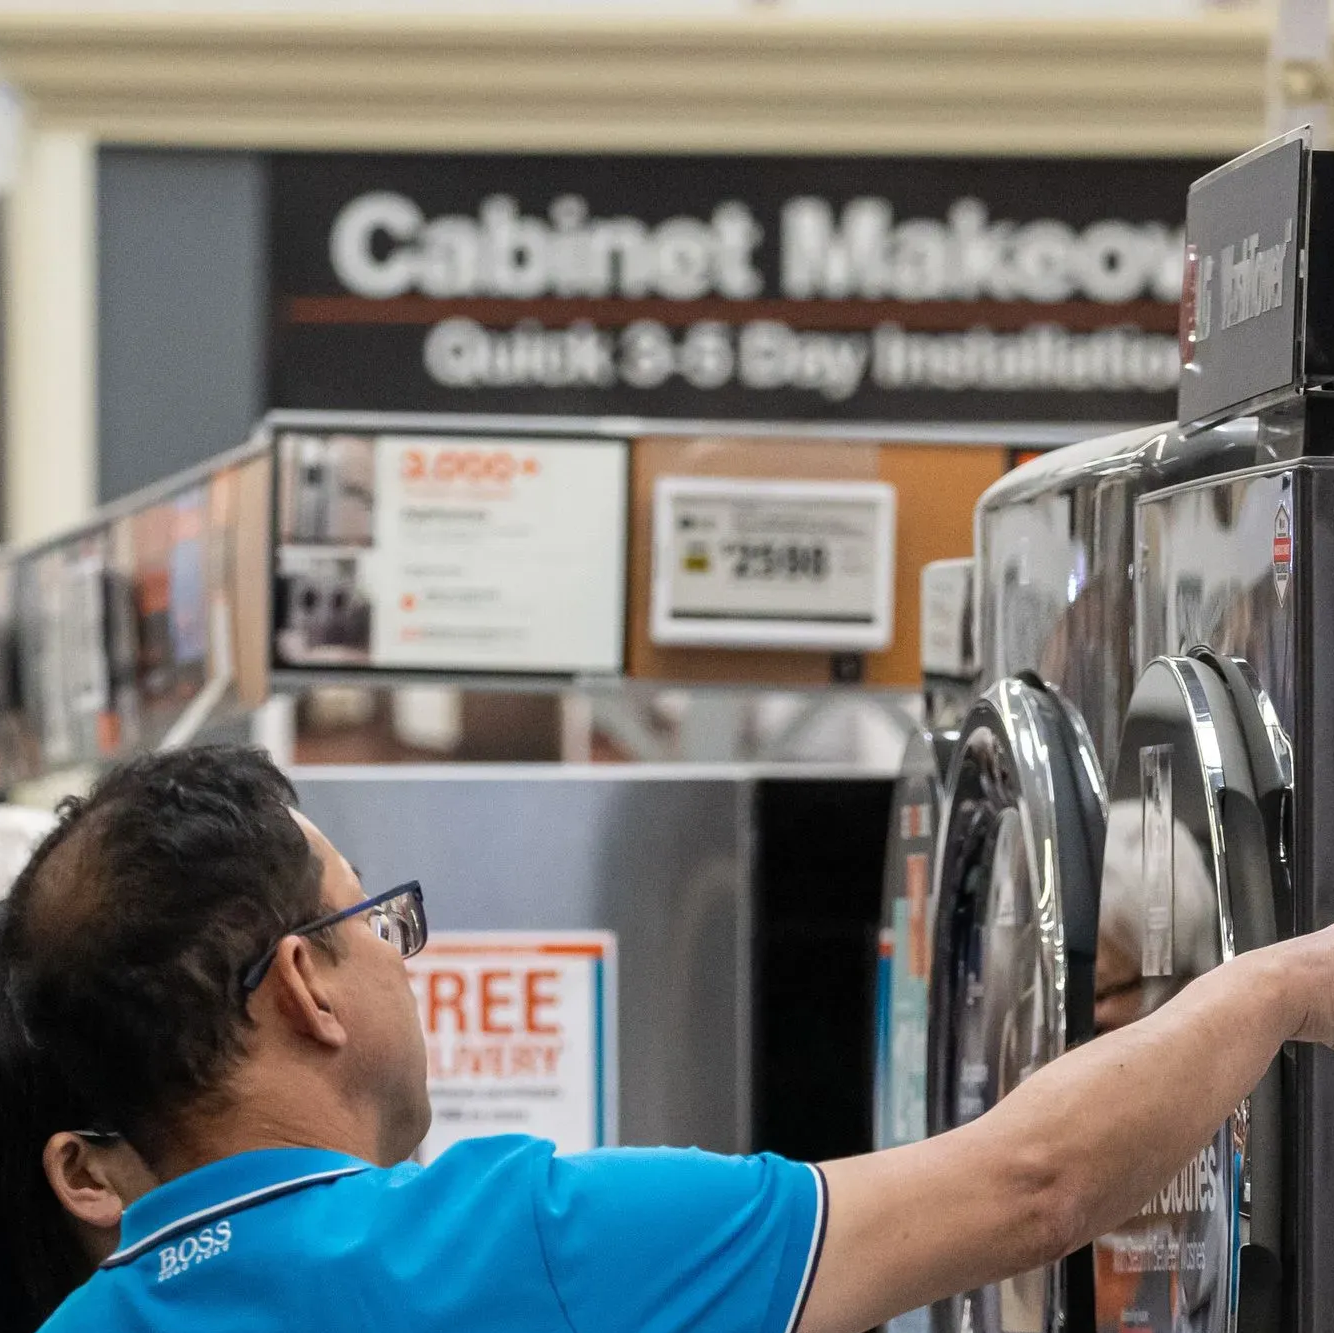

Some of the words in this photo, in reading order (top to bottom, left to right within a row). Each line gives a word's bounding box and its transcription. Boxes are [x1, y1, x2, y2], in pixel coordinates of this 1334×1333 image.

[329, 192, 763, 301] Cabinet
[423, 318, 613, 388] Quick
[622, 319, 732, 388] 3-5
[739, 319, 865, 399] Day
[410, 968, 561, 1036] REE
[158, 1220, 233, 1275] BOSS
